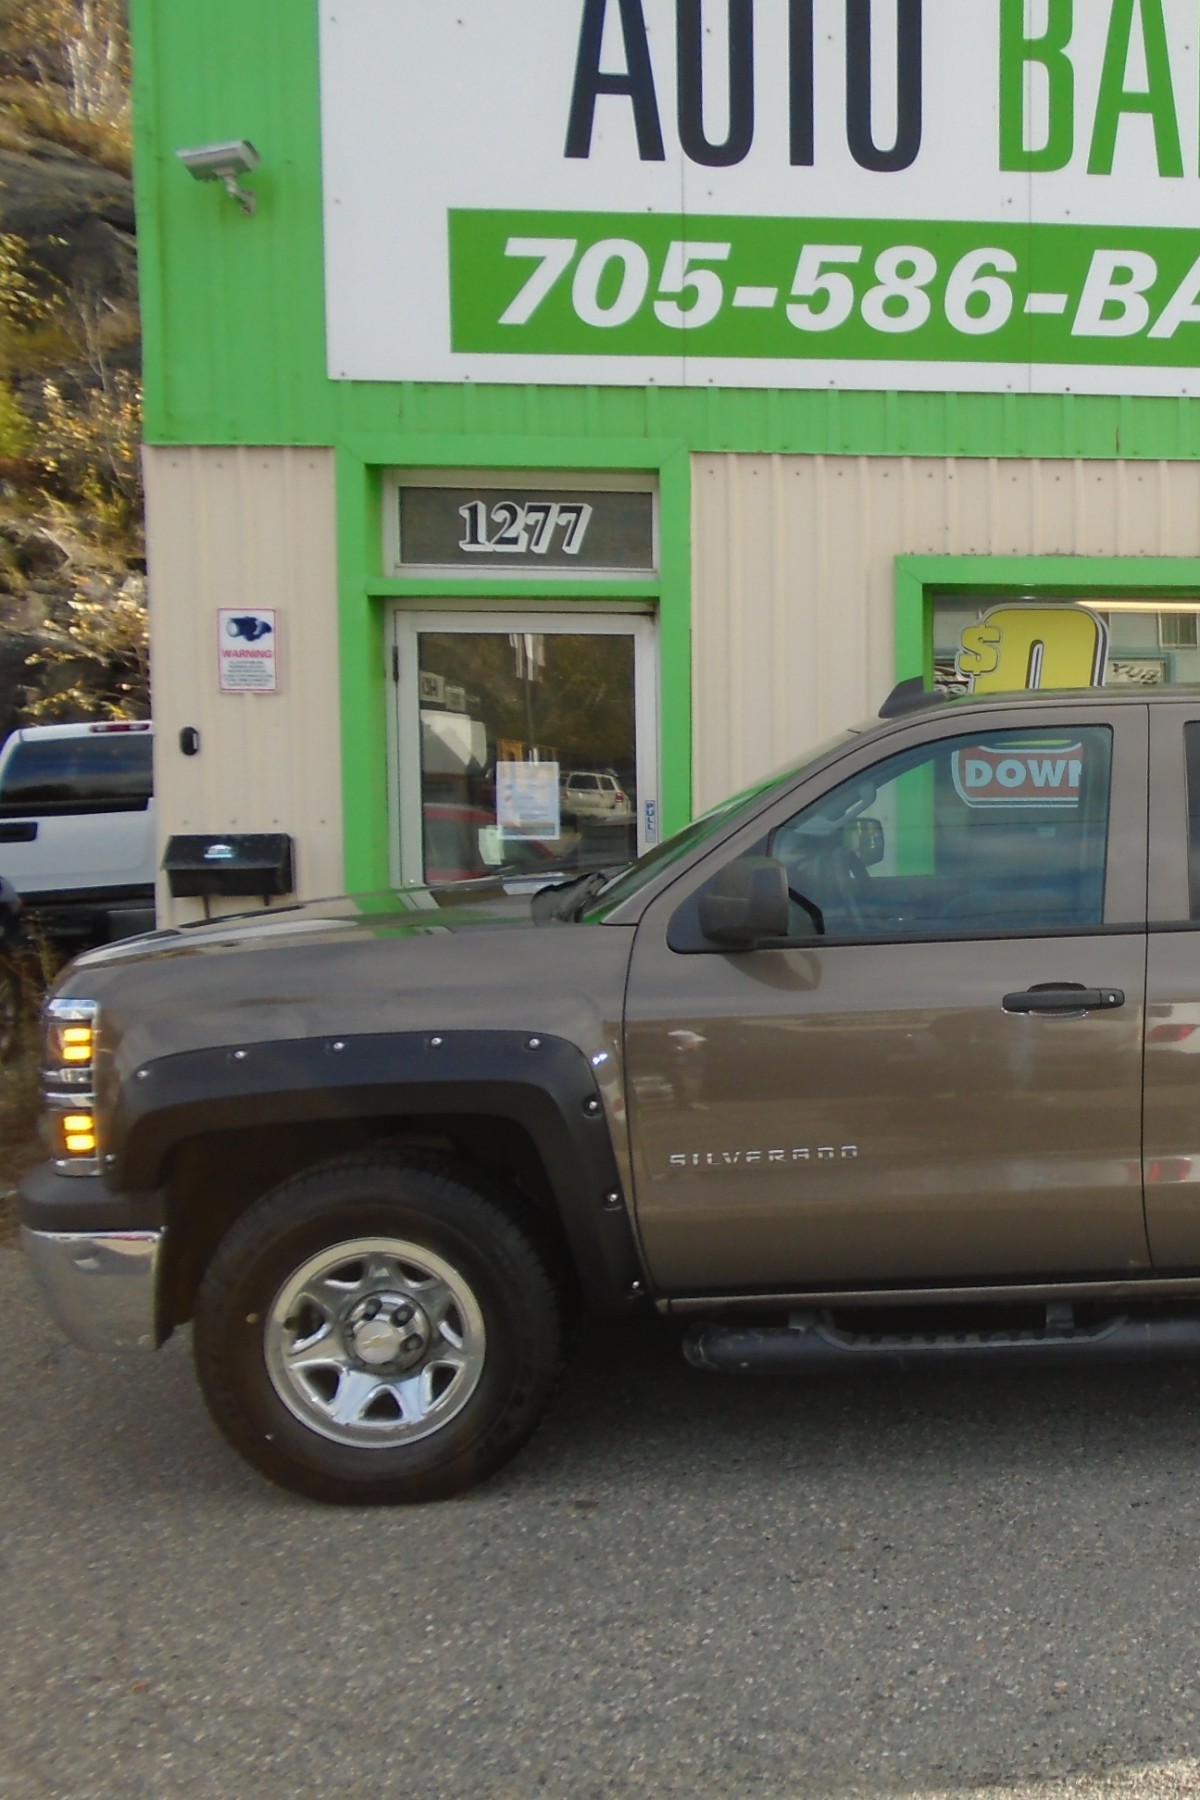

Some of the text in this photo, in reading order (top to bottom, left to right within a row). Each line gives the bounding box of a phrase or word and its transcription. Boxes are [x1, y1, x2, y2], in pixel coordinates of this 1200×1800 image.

[458, 500, 593, 555] 1277
[223, 649, 272, 658] WARNING
[646, 802, 655, 830] PULL
[669, 1145, 857, 1166] SILVERADO
